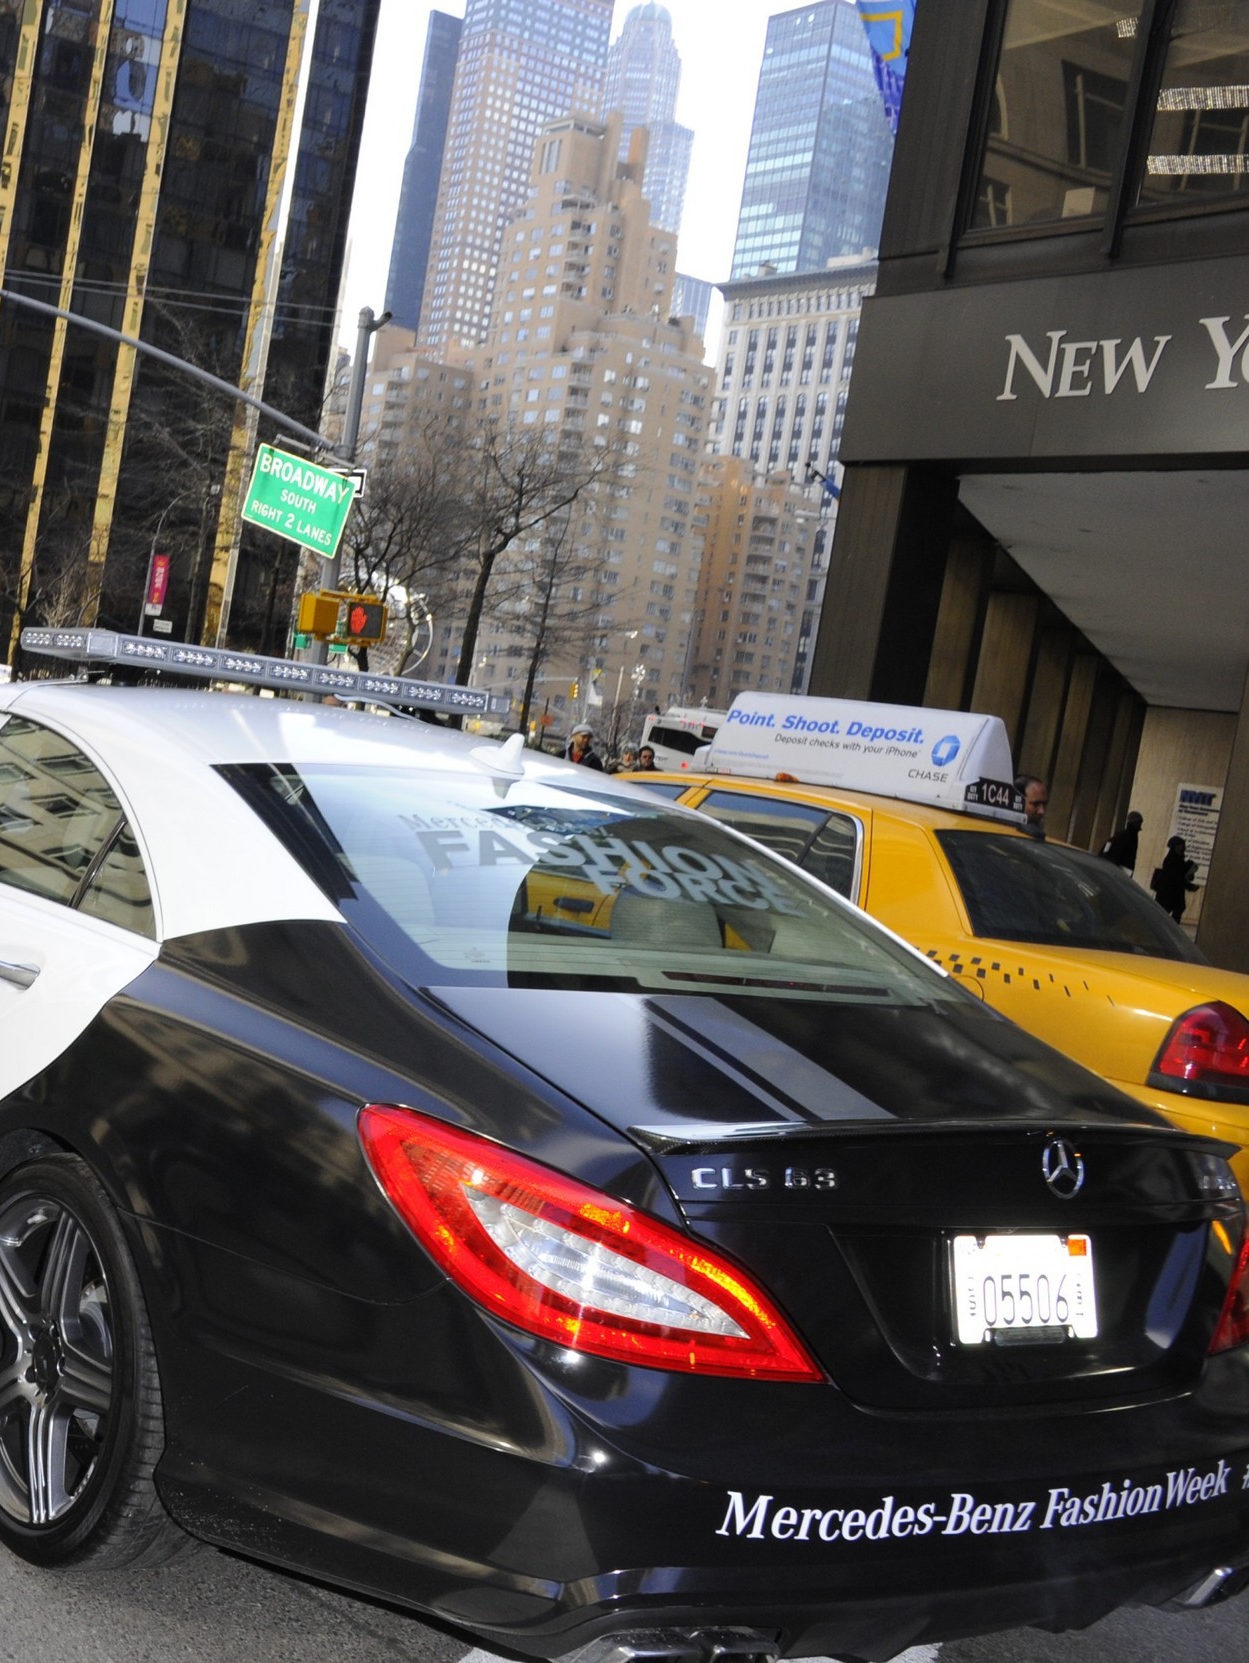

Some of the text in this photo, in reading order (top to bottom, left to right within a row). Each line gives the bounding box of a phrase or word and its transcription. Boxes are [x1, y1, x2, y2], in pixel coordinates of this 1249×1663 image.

[996, 313, 1249, 400] NEW Y
[259, 452, 350, 505] BROADWAY
[280, 489, 317, 514] SOUTH
[251, 500, 332, 546] RIGHT 2 LANES
[727, 709, 924, 744] Point. Shoot. Deposit.
[775, 733, 807, 745] Deposit
[808, 738, 839, 749] checks
[842, 741, 861, 752] with
[863, 746, 883, 755] your
[908, 768, 949, 783] CHASE
[981, 782, 1010, 806] 1C44
[416, 829, 786, 896] FASHION
[582, 864, 808, 918] FORCE
[691, 1167, 839, 1190] CLS 63
[983, 1273, 1070, 1327] 05506
[715, 1490, 1037, 1542] Mercedes-Benz
[1040, 1478, 1160, 1529] Fashion
[1165, 1458, 1232, 1510] Week
